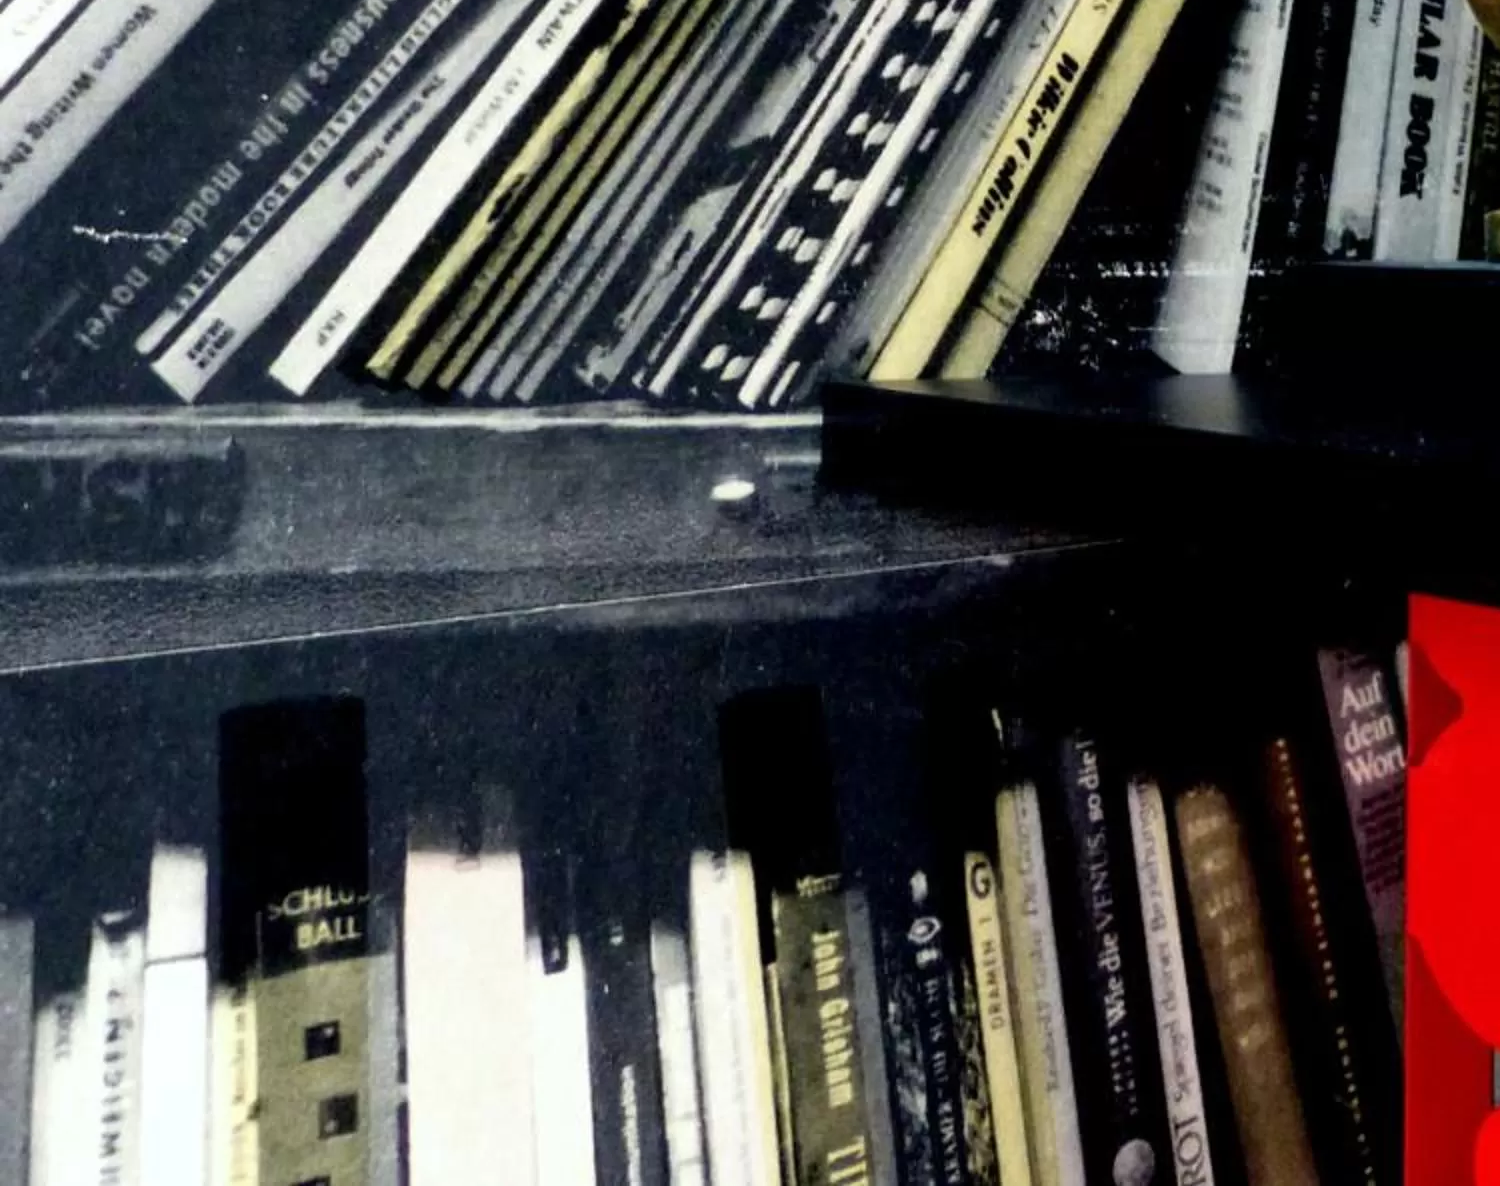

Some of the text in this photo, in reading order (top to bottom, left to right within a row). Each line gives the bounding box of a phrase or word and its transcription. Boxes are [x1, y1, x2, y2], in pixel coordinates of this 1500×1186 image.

[86, 0, 157, 76] Women
[22, 66, 97, 147] Writing
[277, 80, 319, 122] in
[287, 51, 402, 181] LITERATURE
[1020, 52, 1081, 141] Wilkie
[235, 111, 290, 167] the
[341, 142, 386, 191] Trilogy
[1398, 93, 1435, 200] BOOK
[143, 159, 247, 271] modern
[230, 180, 291, 246] BOOK
[967, 136, 1036, 240] Collins
[72, 264, 157, 354] novel
[166, 242, 236, 319] THREE
[1340, 671, 1383, 716] Auf
[1343, 713, 1396, 753] dein
[1073, 748, 1101, 790] die
[1346, 745, 1407, 787] Wort
[1087, 792, 1104, 822] so
[294, 915, 362, 951] BALL
[808, 929, 848, 991] John
[1094, 932, 1122, 970] die
[981, 940, 1004, 1030] DRAMEN
[1101, 974, 1129, 1027] Wie
[813, 995, 863, 1108] Grisham
